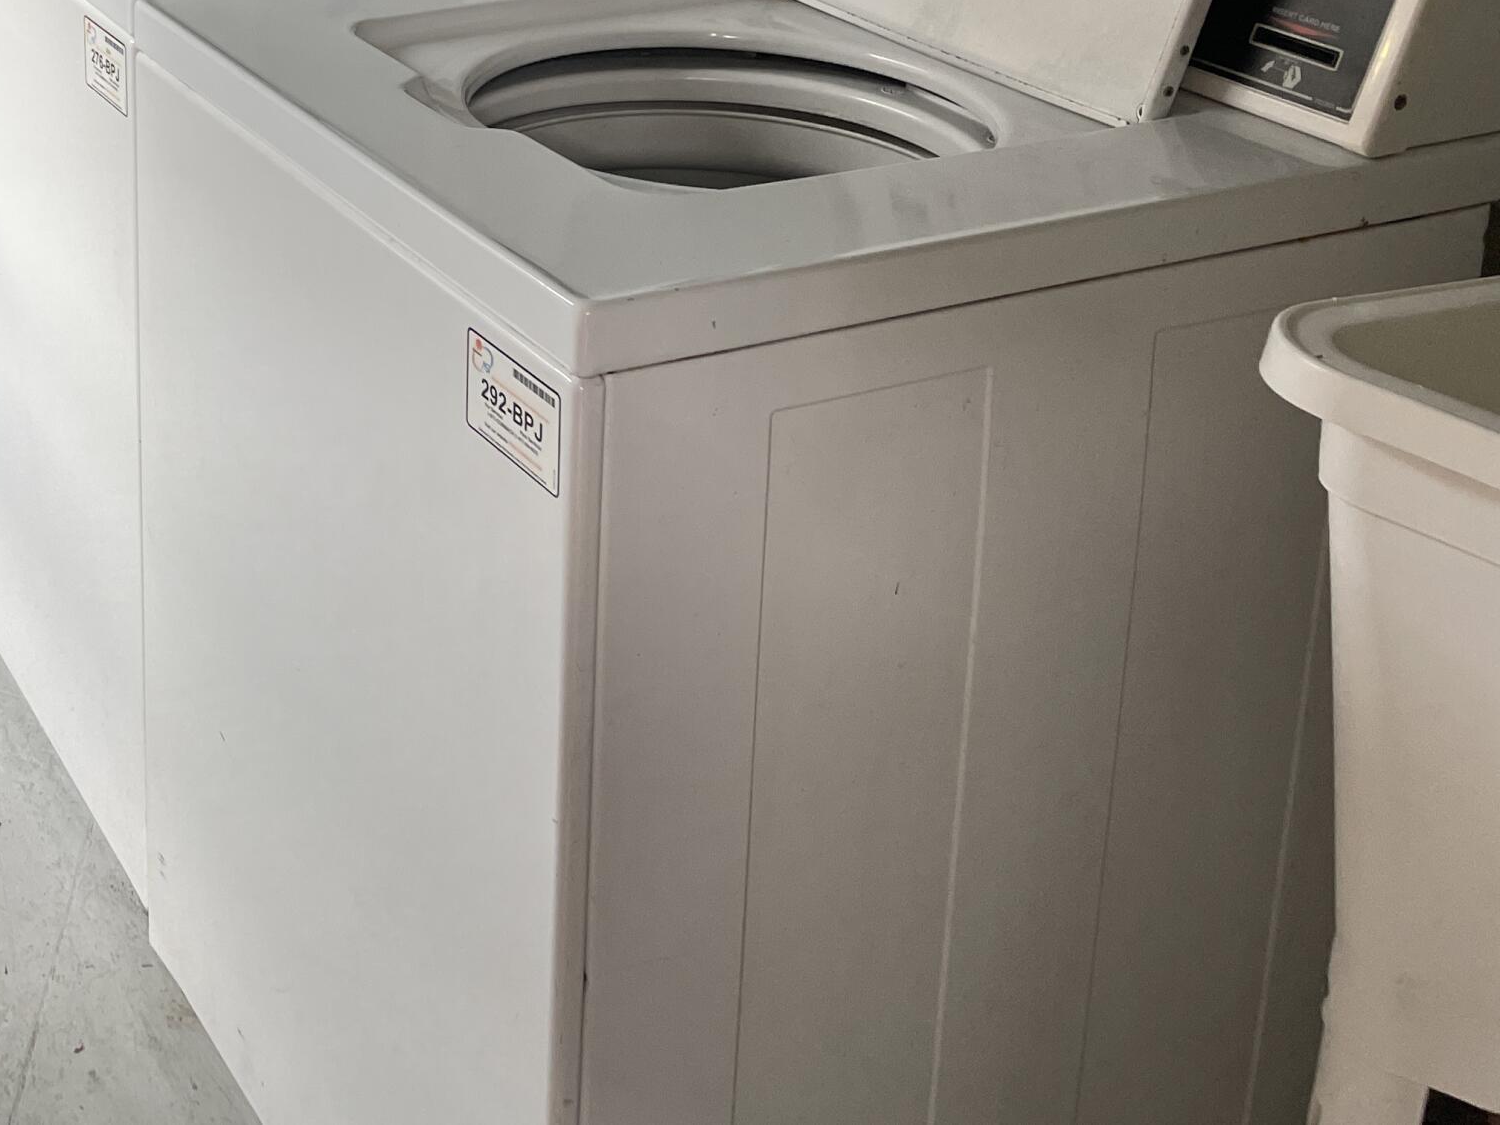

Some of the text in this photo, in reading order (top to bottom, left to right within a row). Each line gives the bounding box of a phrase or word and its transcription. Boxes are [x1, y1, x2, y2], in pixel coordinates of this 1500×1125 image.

[1272, 6, 1340, 32] INSERT CARD HERE
[481, 378, 544, 443] 292-BPJ
